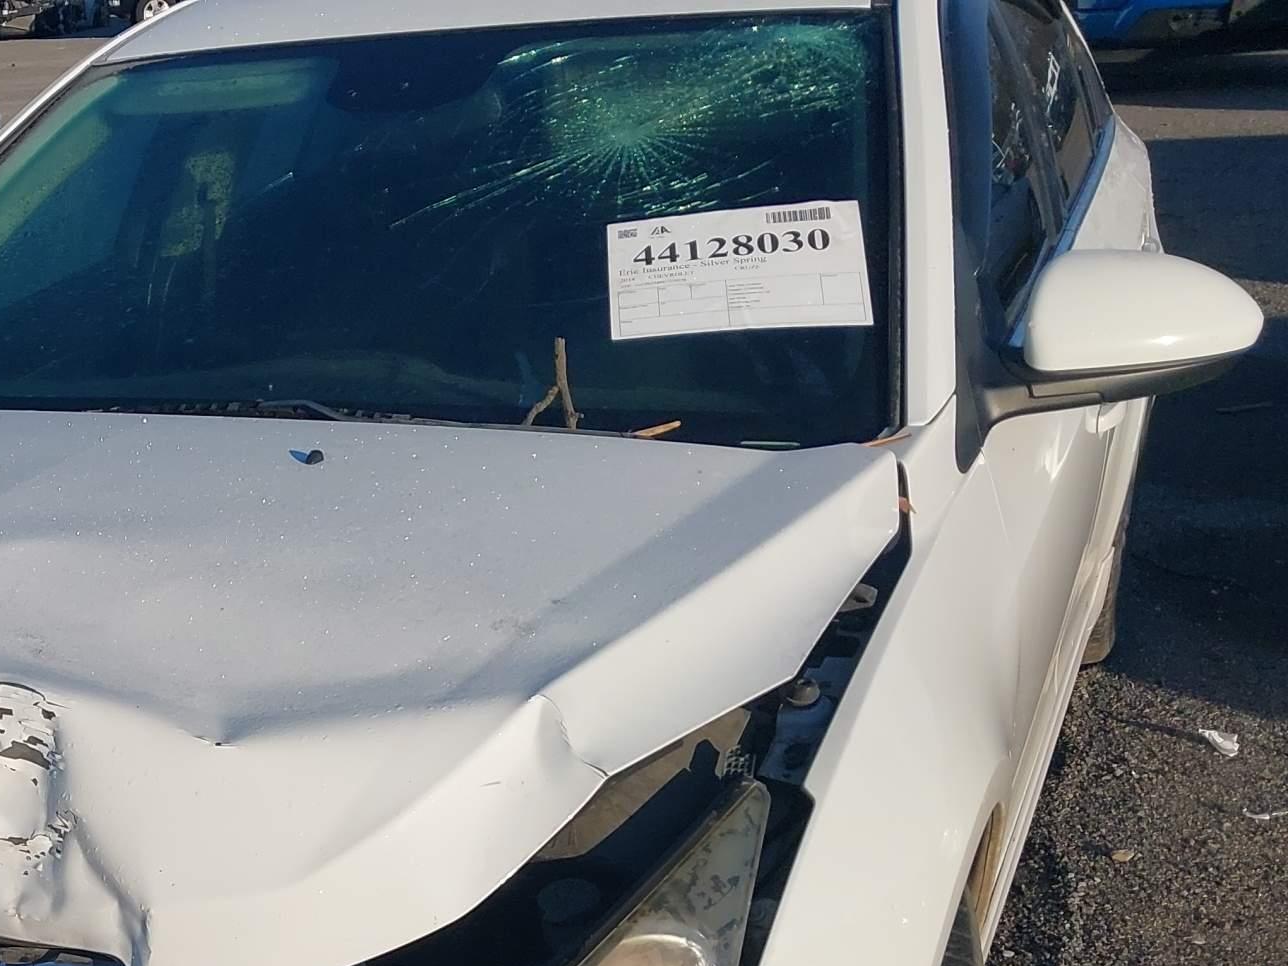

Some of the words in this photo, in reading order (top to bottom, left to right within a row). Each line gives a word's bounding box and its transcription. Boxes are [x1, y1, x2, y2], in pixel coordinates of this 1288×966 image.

[633, 228, 830, 266] 44128030
[642, 264, 690, 273] Insurance
[700, 259, 729, 267] Silver
[733, 256, 768, 264] Spring
